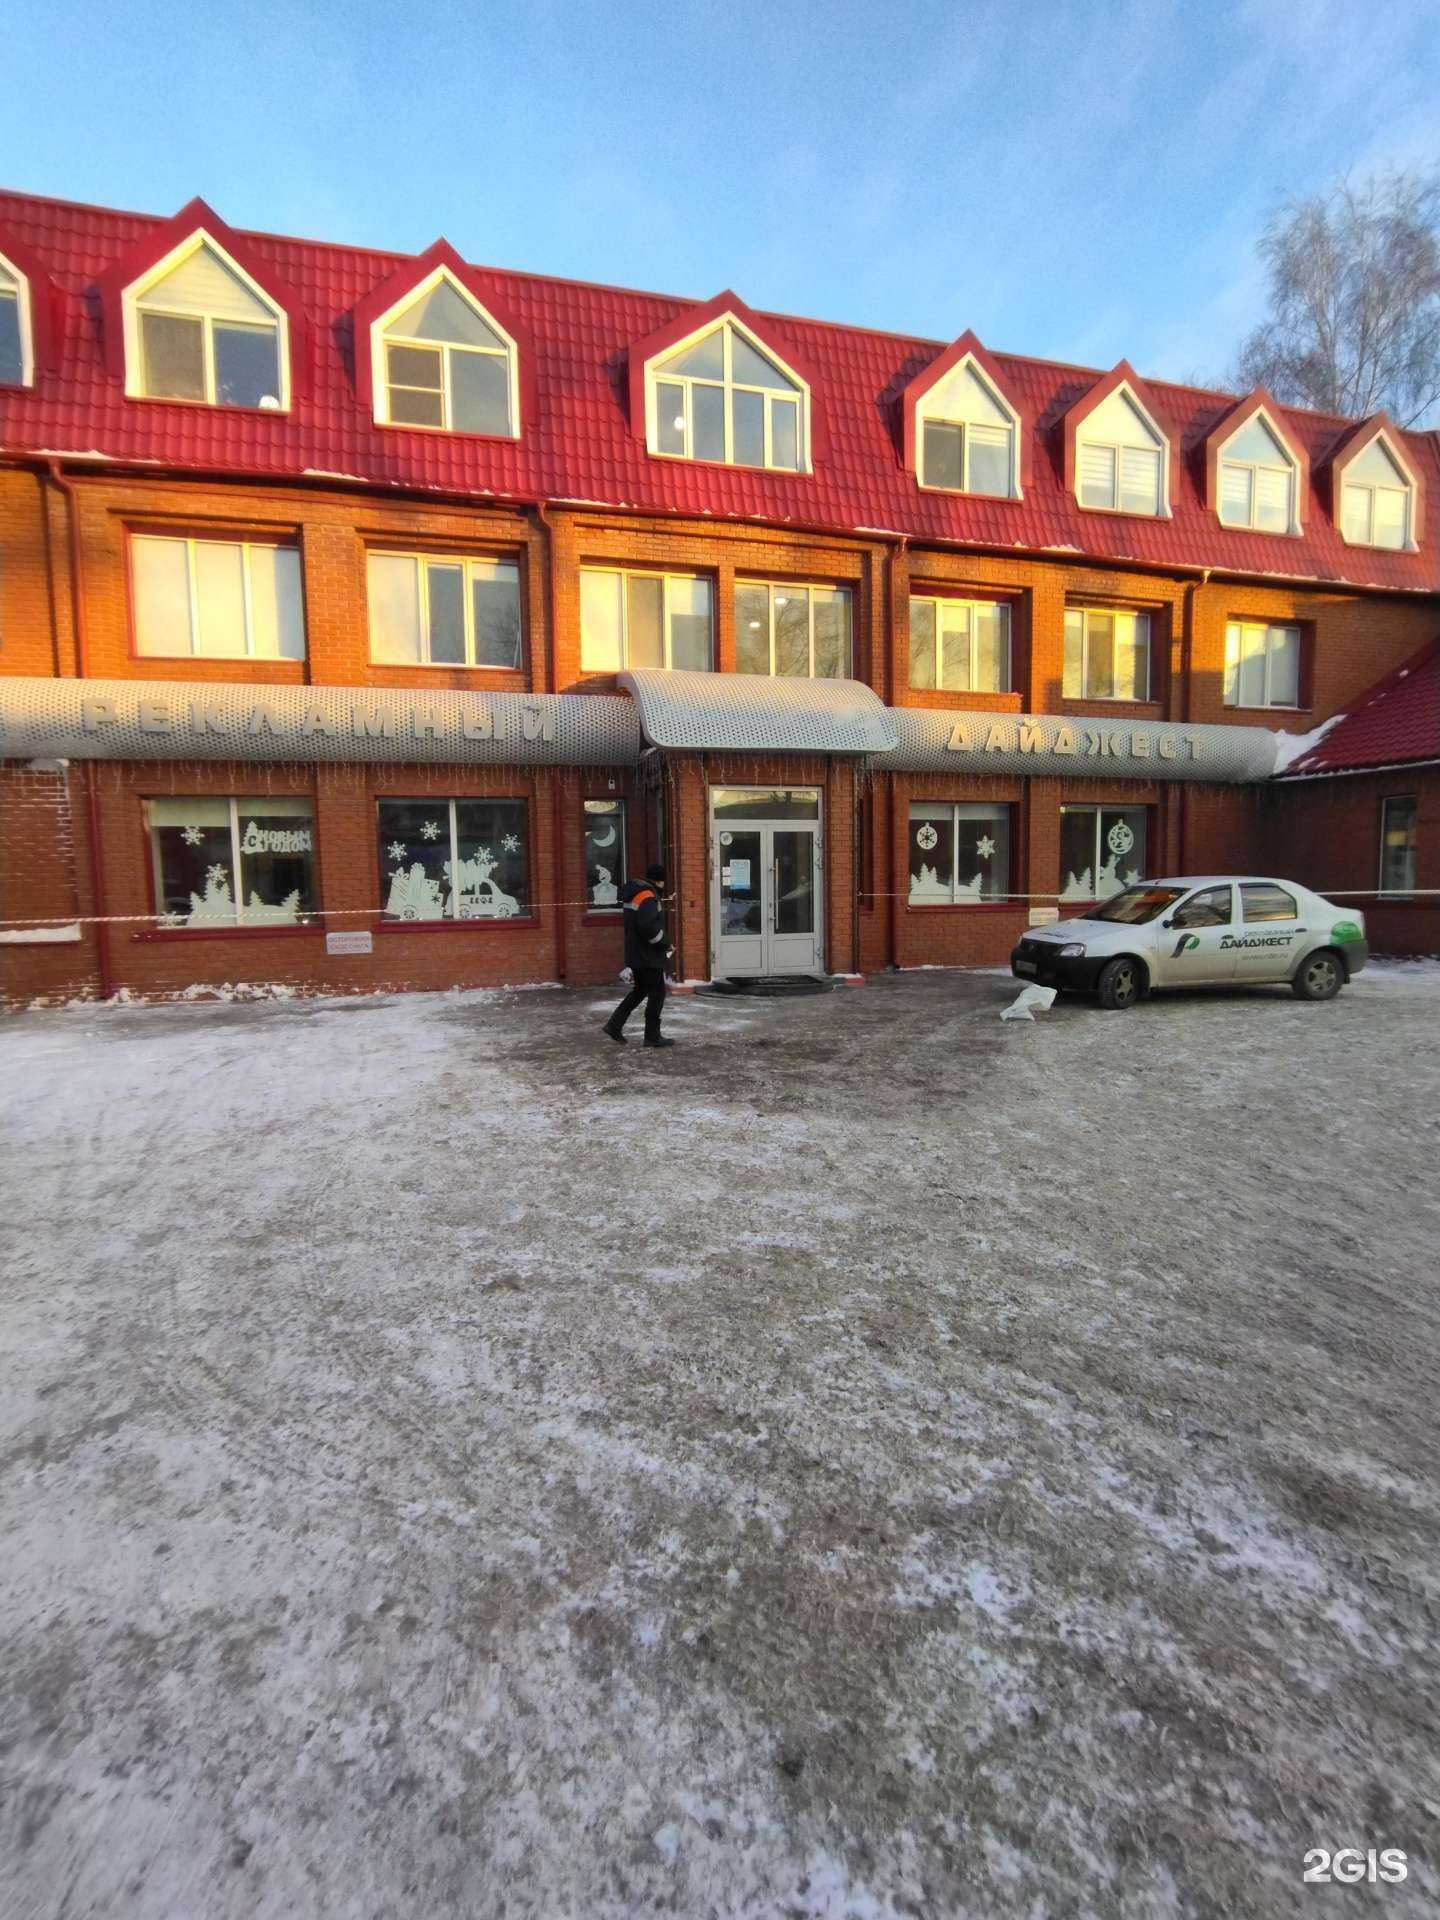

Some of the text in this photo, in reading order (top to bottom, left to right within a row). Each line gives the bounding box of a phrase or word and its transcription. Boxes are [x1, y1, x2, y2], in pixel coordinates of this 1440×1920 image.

[82, 697, 1206, 759] РЕКЛАМНЫЙ ДАЙДЖЕСТ
[1220, 936, 1293, 949] ДАЙДЖЕСТ
